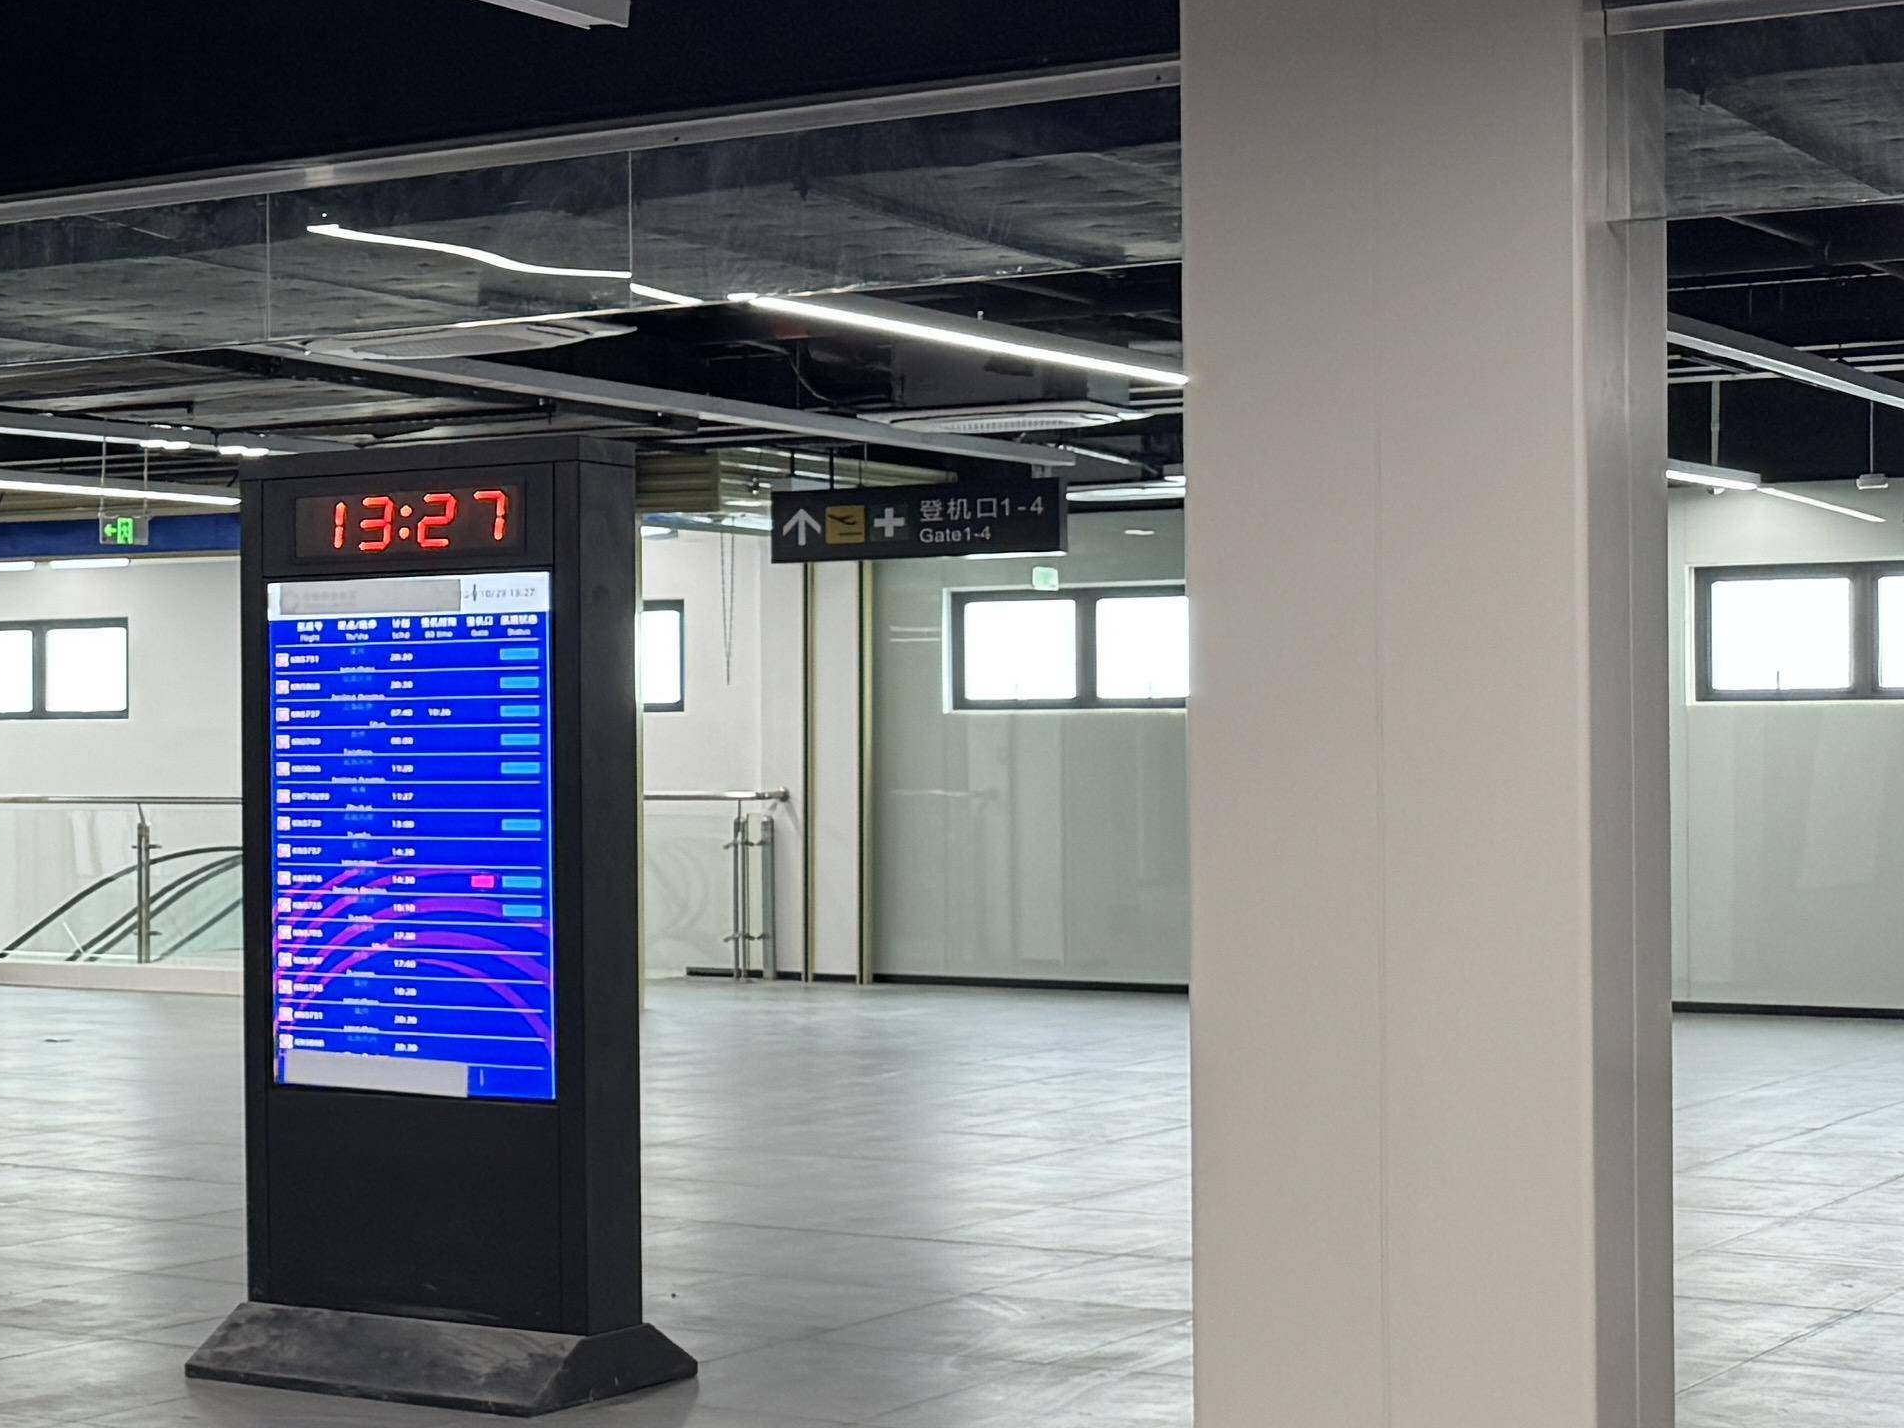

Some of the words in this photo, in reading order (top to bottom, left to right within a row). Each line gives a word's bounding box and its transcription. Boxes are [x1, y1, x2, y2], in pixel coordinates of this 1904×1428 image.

[332, 490, 508, 553] 13:27
[920, 496, 1044, 523] 登机口1-4
